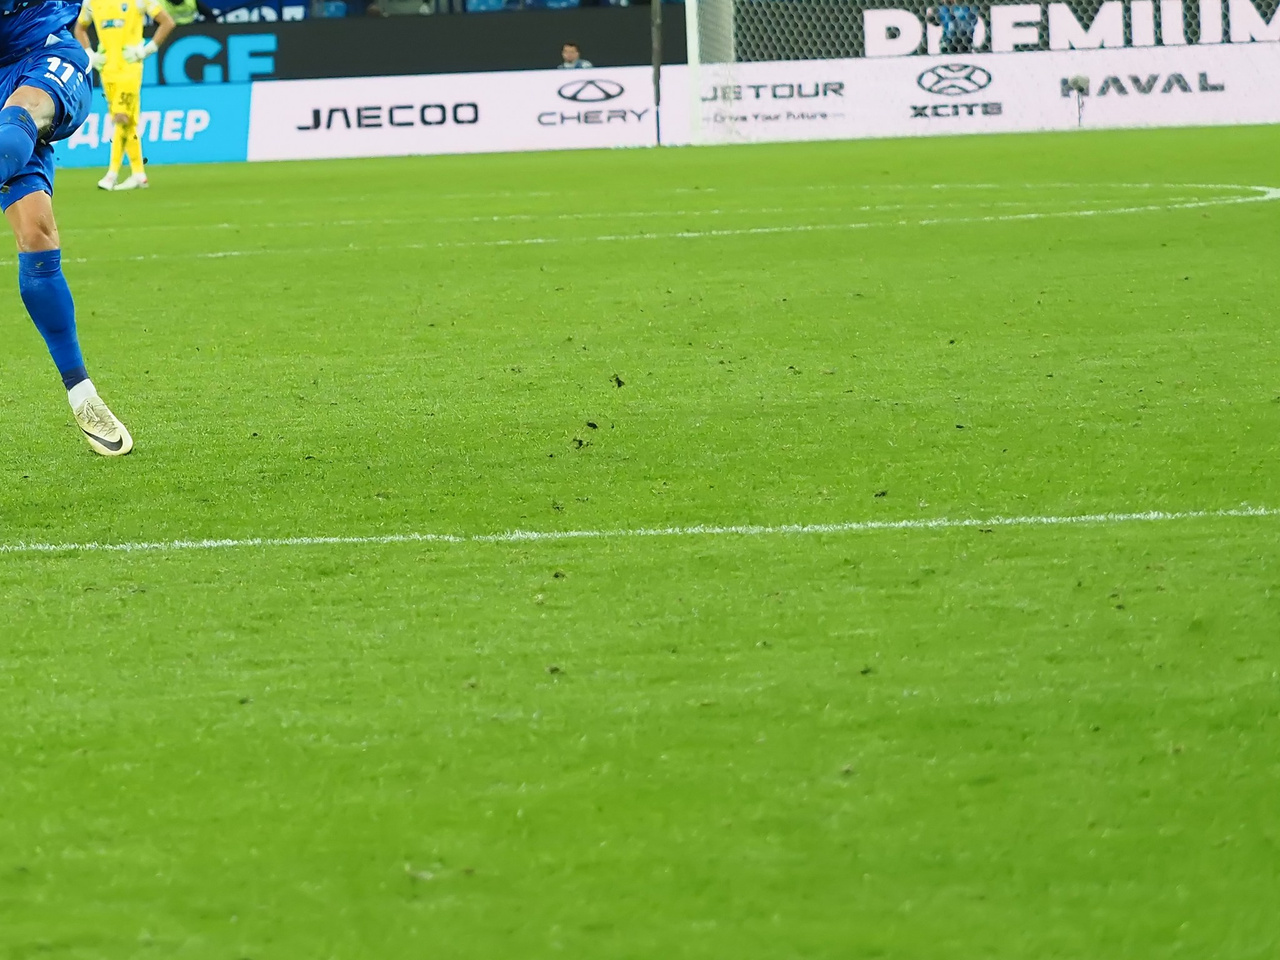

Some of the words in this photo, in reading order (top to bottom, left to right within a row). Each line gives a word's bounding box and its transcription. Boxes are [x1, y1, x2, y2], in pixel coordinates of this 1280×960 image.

[47, 56, 75, 84] 11
[701, 81, 845, 102] JETOUR
[297, 102, 479, 131] JAECOO
[537, 108, 649, 126] CHERY
